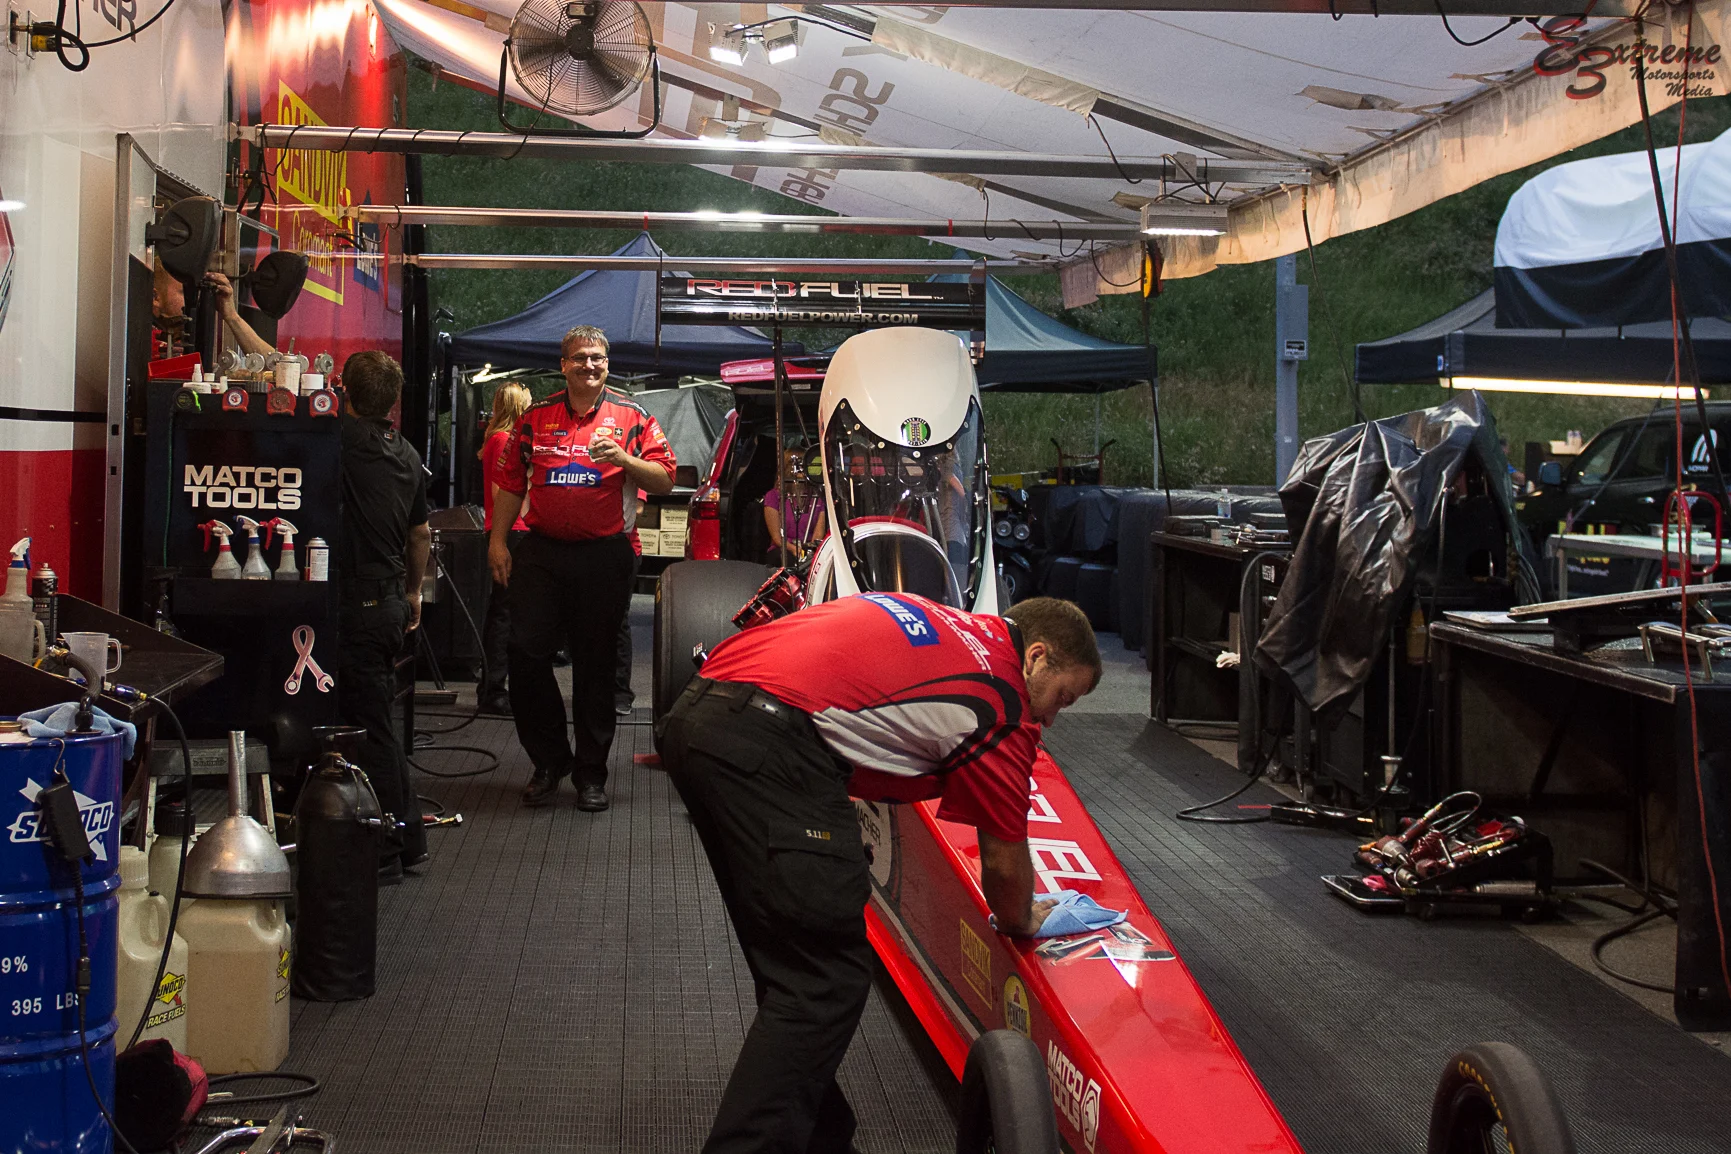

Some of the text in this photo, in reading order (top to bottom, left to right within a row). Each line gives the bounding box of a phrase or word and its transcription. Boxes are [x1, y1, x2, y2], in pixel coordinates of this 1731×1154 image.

[728, 311, 918, 324] REDFUELPOWER.COM
[184, 464, 303, 489] MATCO
[550, 471, 597, 486] LOWE'S
[184, 485, 302, 510] TOOLS
[864, 594, 927, 637] LOWE'S
[157, 977, 184, 998] UNOCO
[11, 997, 42, 1016] 395
[147, 1012, 168, 1028] RACE
[1048, 1039, 1084, 1100] MATCO
